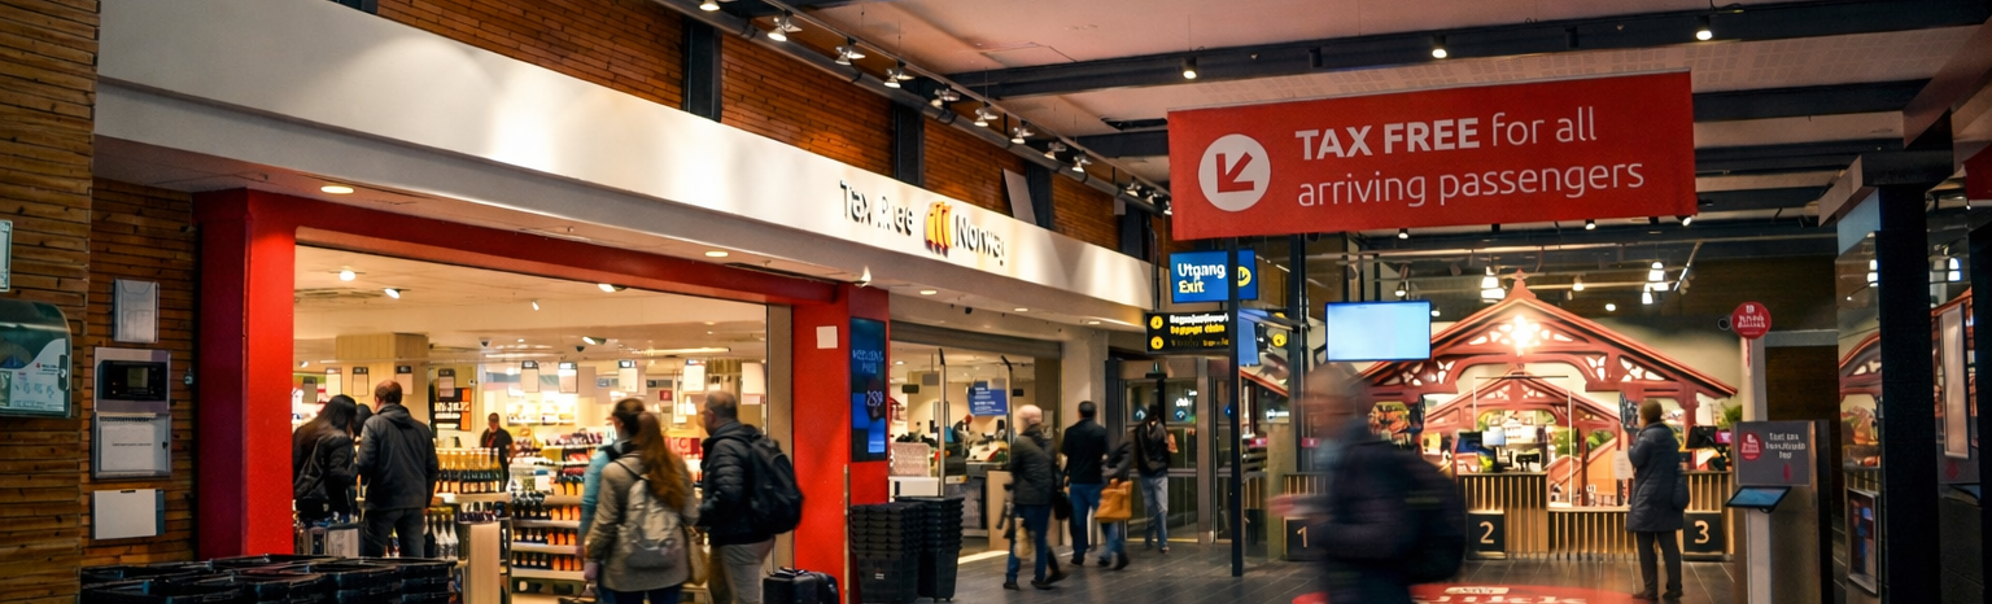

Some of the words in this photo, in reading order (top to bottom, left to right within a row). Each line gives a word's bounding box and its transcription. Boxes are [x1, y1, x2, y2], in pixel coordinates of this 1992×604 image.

[1295, 125, 1373, 160] TAX
[1384, 117, 1480, 154] FREE
[1492, 112, 1545, 147] for
[1555, 106, 1597, 143] all
[1298, 171, 1426, 207] arriving
[1440, 163, 1644, 206] passengers
[839, 179, 872, 226] Tax
[1177, 262, 1226, 281] Utgang
[1178, 280, 1205, 294] Exit
[1296, 525, 1308, 548] 1
[1479, 520, 1495, 544] 2
[1694, 519, 1710, 544] 3
